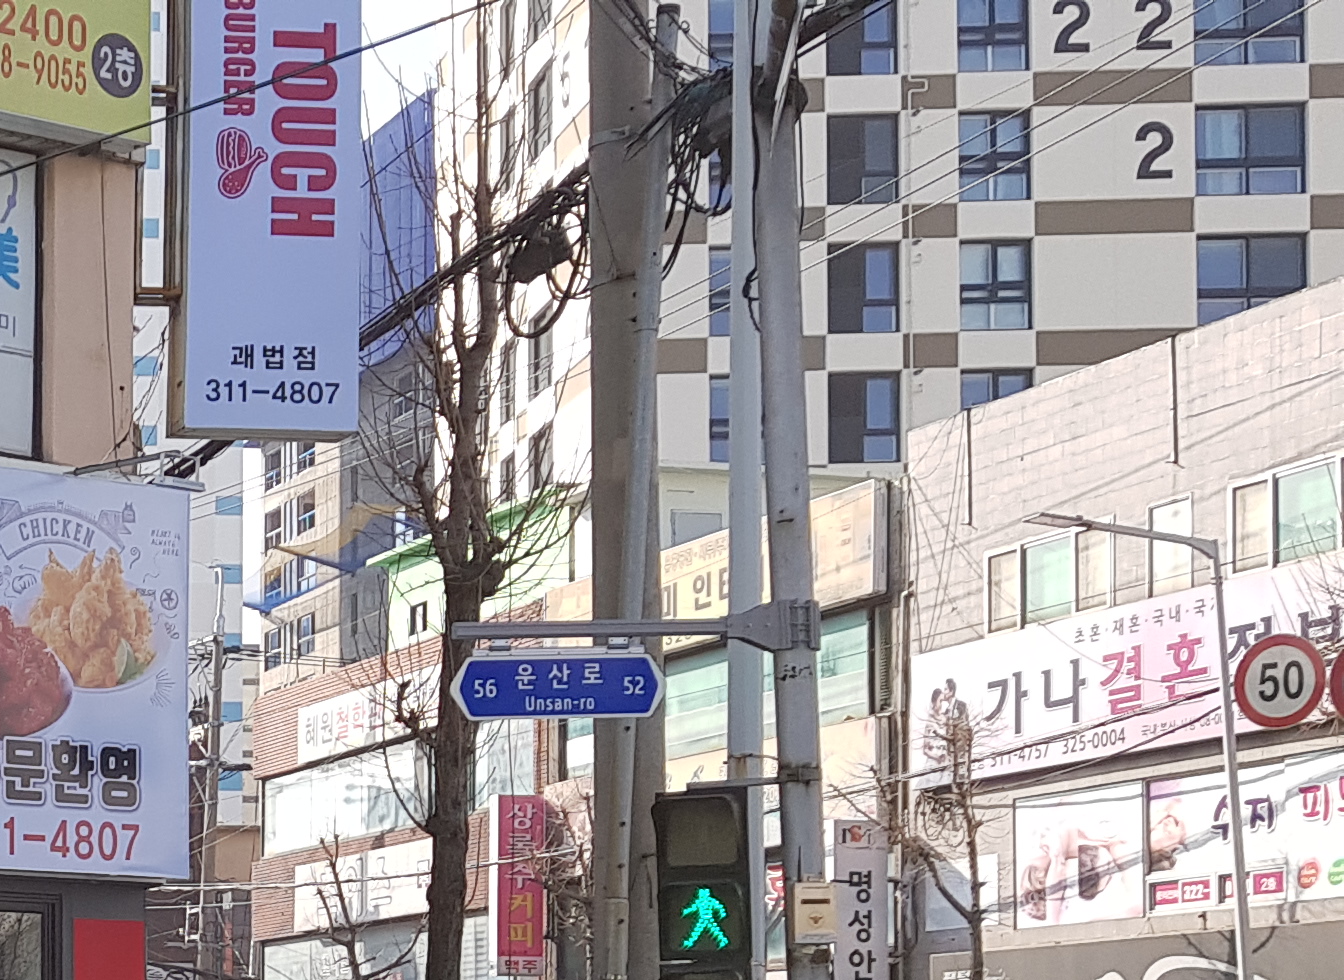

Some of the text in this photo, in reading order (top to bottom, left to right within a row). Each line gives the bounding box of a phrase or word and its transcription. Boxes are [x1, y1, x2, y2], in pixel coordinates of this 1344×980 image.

[99, 46, 136, 88] 2층
[270, 22, 338, 238] TOUCH
[205, 378, 340, 404] 311-4807
[18, 517, 96, 548] CHICKEN
[474, 663, 645, 698] 56 운산로 52
[1258, 660, 1304, 702] 50
[525, 696, 595, 711] Unsan-ro
[1062, 727, 1126, 754] 325-0004
